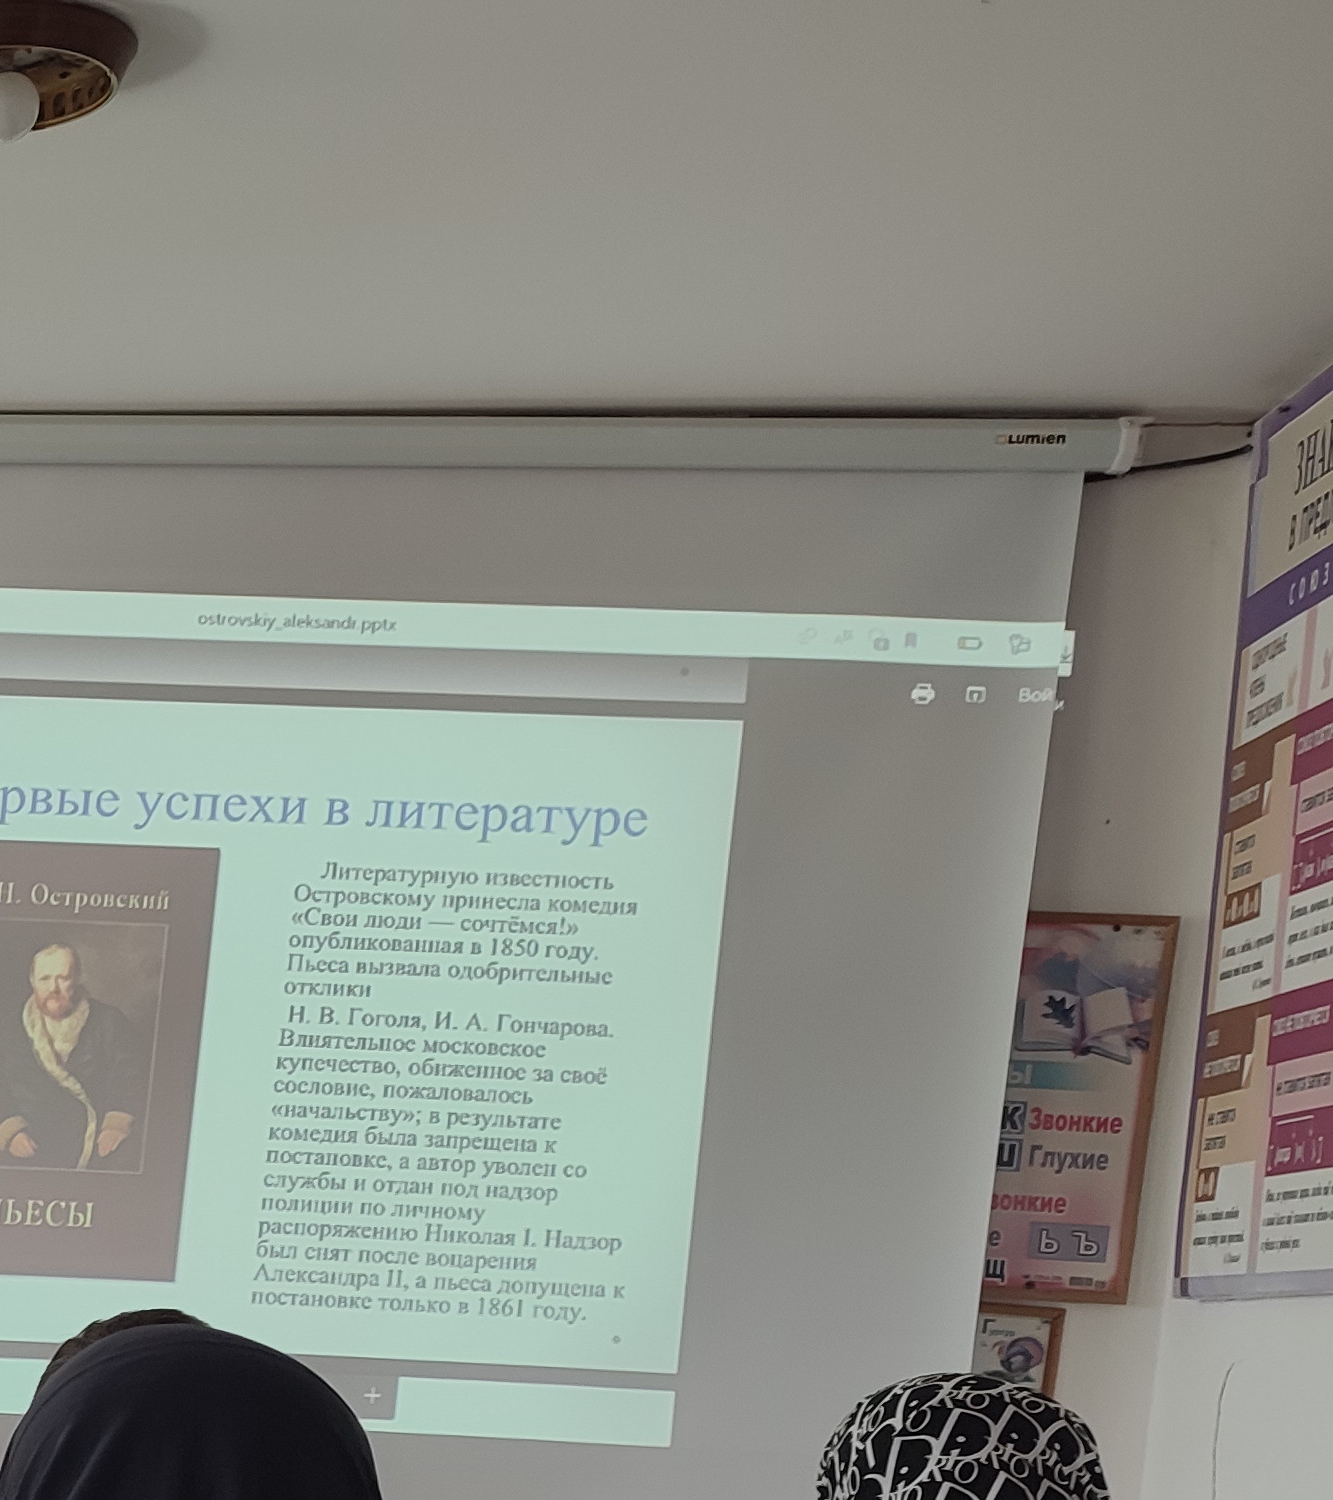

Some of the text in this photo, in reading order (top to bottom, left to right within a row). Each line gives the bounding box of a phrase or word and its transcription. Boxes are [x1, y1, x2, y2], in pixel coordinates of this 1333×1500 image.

[132, 789, 309, 831] успехи
[324, 798, 350, 827] в
[365, 798, 648, 848] литературе
[319, 861, 615, 891] Литературную известность
[30, 882, 171, 914] Островский
[293, 883, 638, 916] Островскому принесла комедия
[291, 906, 579, 936] «Свои люди сочтёмся!»
[288, 930, 598, 966] опубликованная в 1850 году.
[287, 952, 613, 986] Пьеса вызвала одобрительные
[283, 981, 372, 998] отклики
[347, 1006, 614, 1041] Гоголя, Гончарова.
[277, 1027, 547, 1058] Влиятельное московское
[275, 1056, 608, 1085] купечество, обиженное своё
[273, 1079, 534, 1105] сословие, пожаловалось
[271, 1104, 562, 1132] «начальству»; результате
[1028, 1106, 1124, 1135] Звонкие
[268, 1125, 538, 1154] комедия была запрещена
[264, 1149, 557, 1180] постановке, автор уволен
[1028, 1144, 1110, 1175] Глухие
[263, 1170, 558, 1206] службы отдан под надзор
[261, 1197, 486, 1226] полиции личному
[257, 1220, 623, 1256] распоряжению Николая Надзор
[255, 1238, 537, 1274] был снят после воцарения
[252, 1263, 606, 1300] Александра пьеса допущена
[251, 1290, 586, 1325] постановке только 1861 году.
